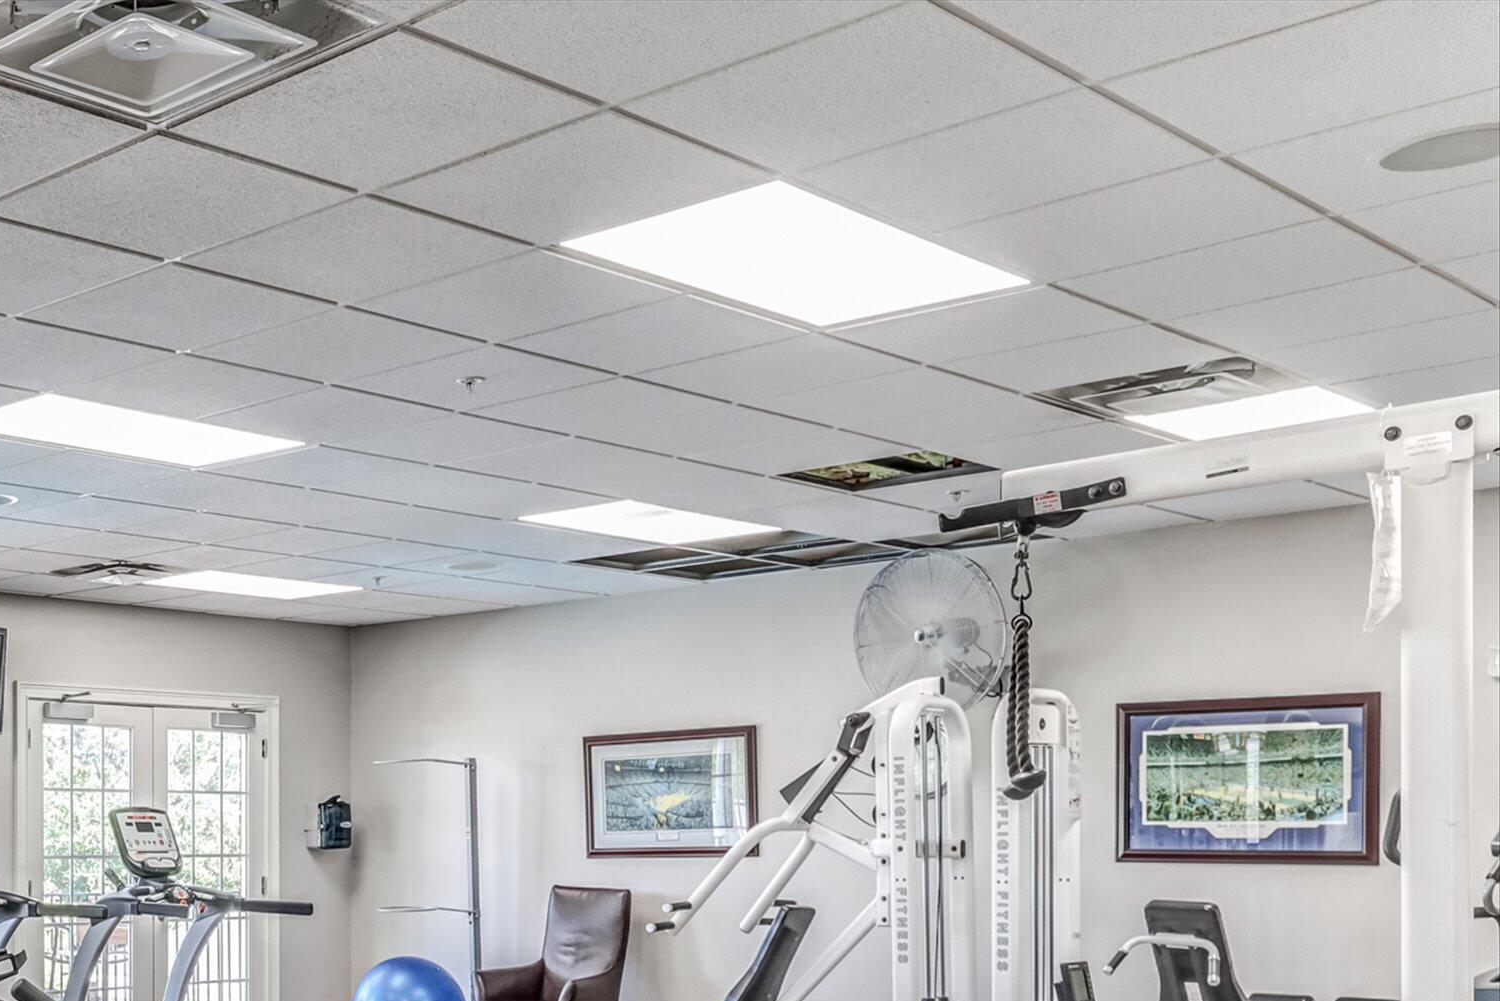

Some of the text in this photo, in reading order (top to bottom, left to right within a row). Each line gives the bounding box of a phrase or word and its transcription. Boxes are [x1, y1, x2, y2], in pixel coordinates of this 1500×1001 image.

[893, 756, 909, 964] INFLIGHT FITNESS
[996, 891, 1010, 972] FITNESS
